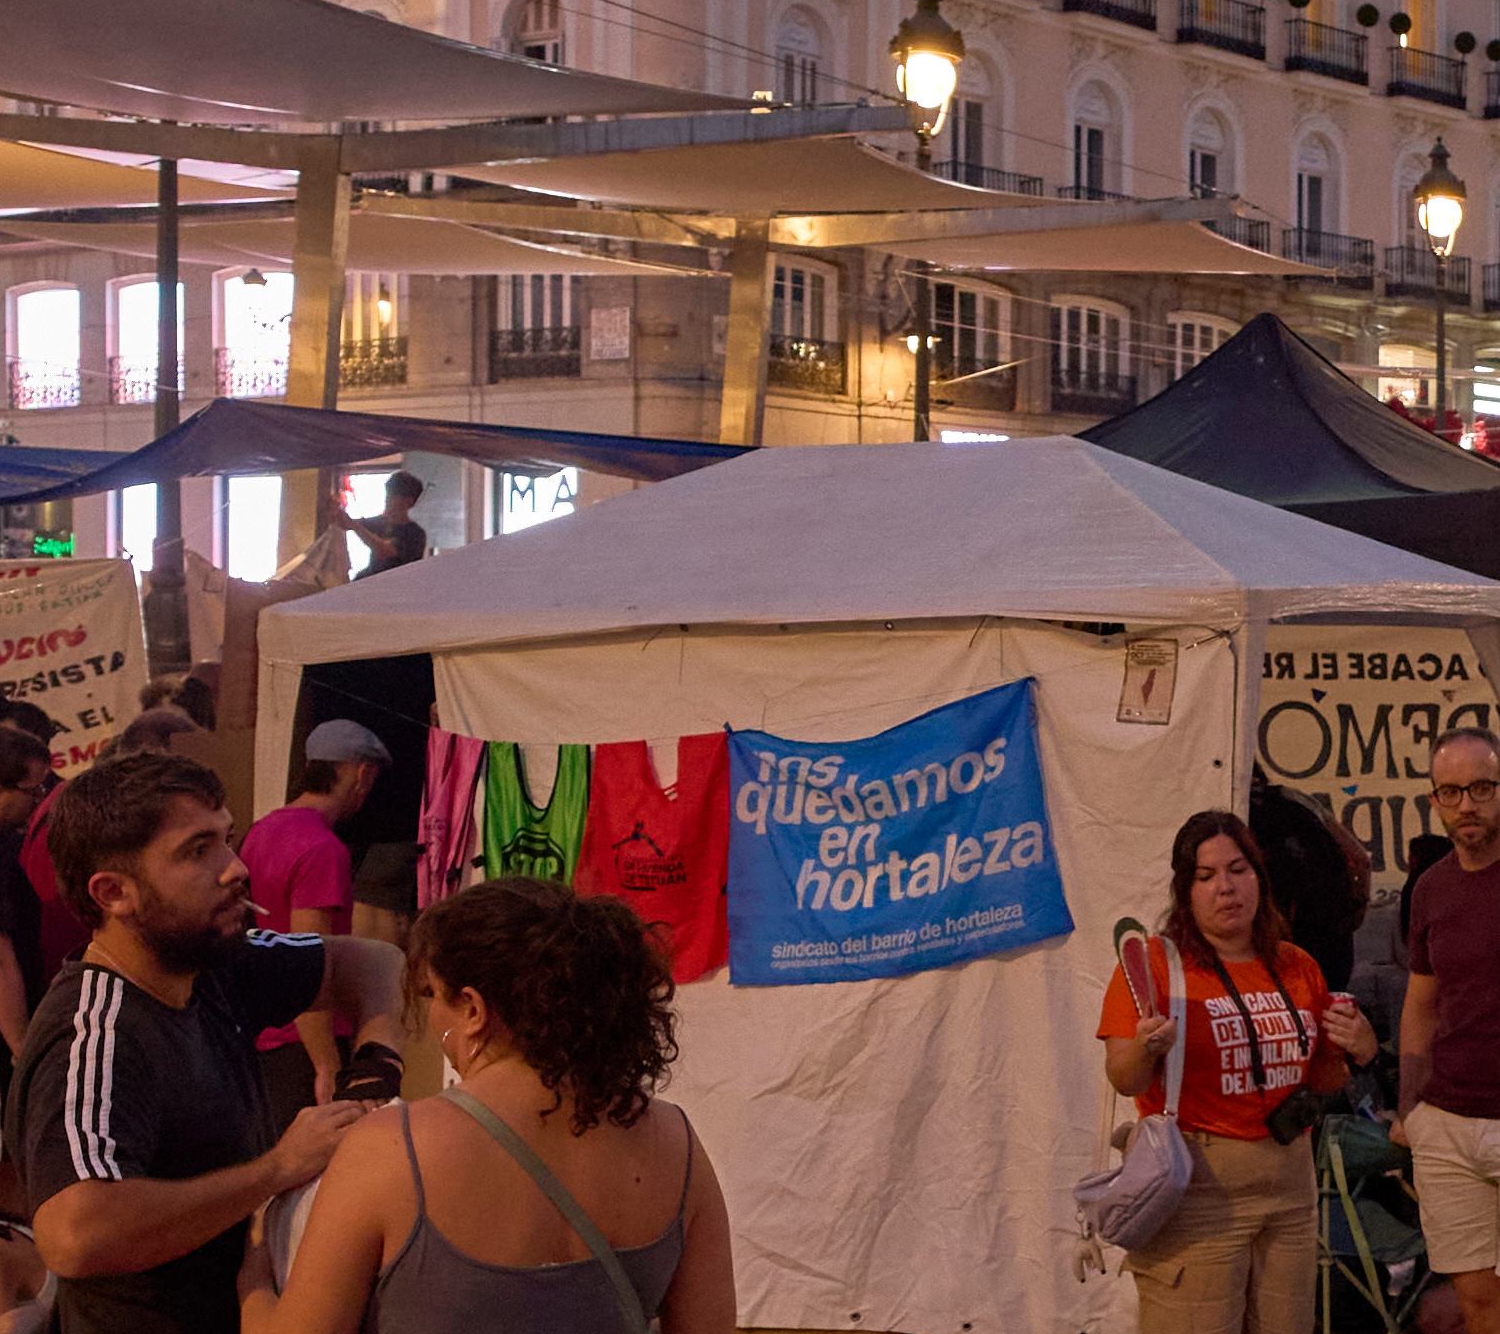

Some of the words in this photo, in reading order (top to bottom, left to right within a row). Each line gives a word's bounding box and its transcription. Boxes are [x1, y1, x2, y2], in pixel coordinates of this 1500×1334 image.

[734, 736, 1008, 835] quedamos
[794, 820, 1044, 912] hortaleza
[817, 821, 883, 869] en
[771, 938, 839, 959] sindicato
[841, 934, 867, 954] del
[871, 924, 916, 951] barrio
[919, 920, 942, 942] de
[944, 901, 1024, 936] hortaleza
[1221, 1071, 1245, 1095] DE
[1245, 1065, 1303, 1094] MDRID
